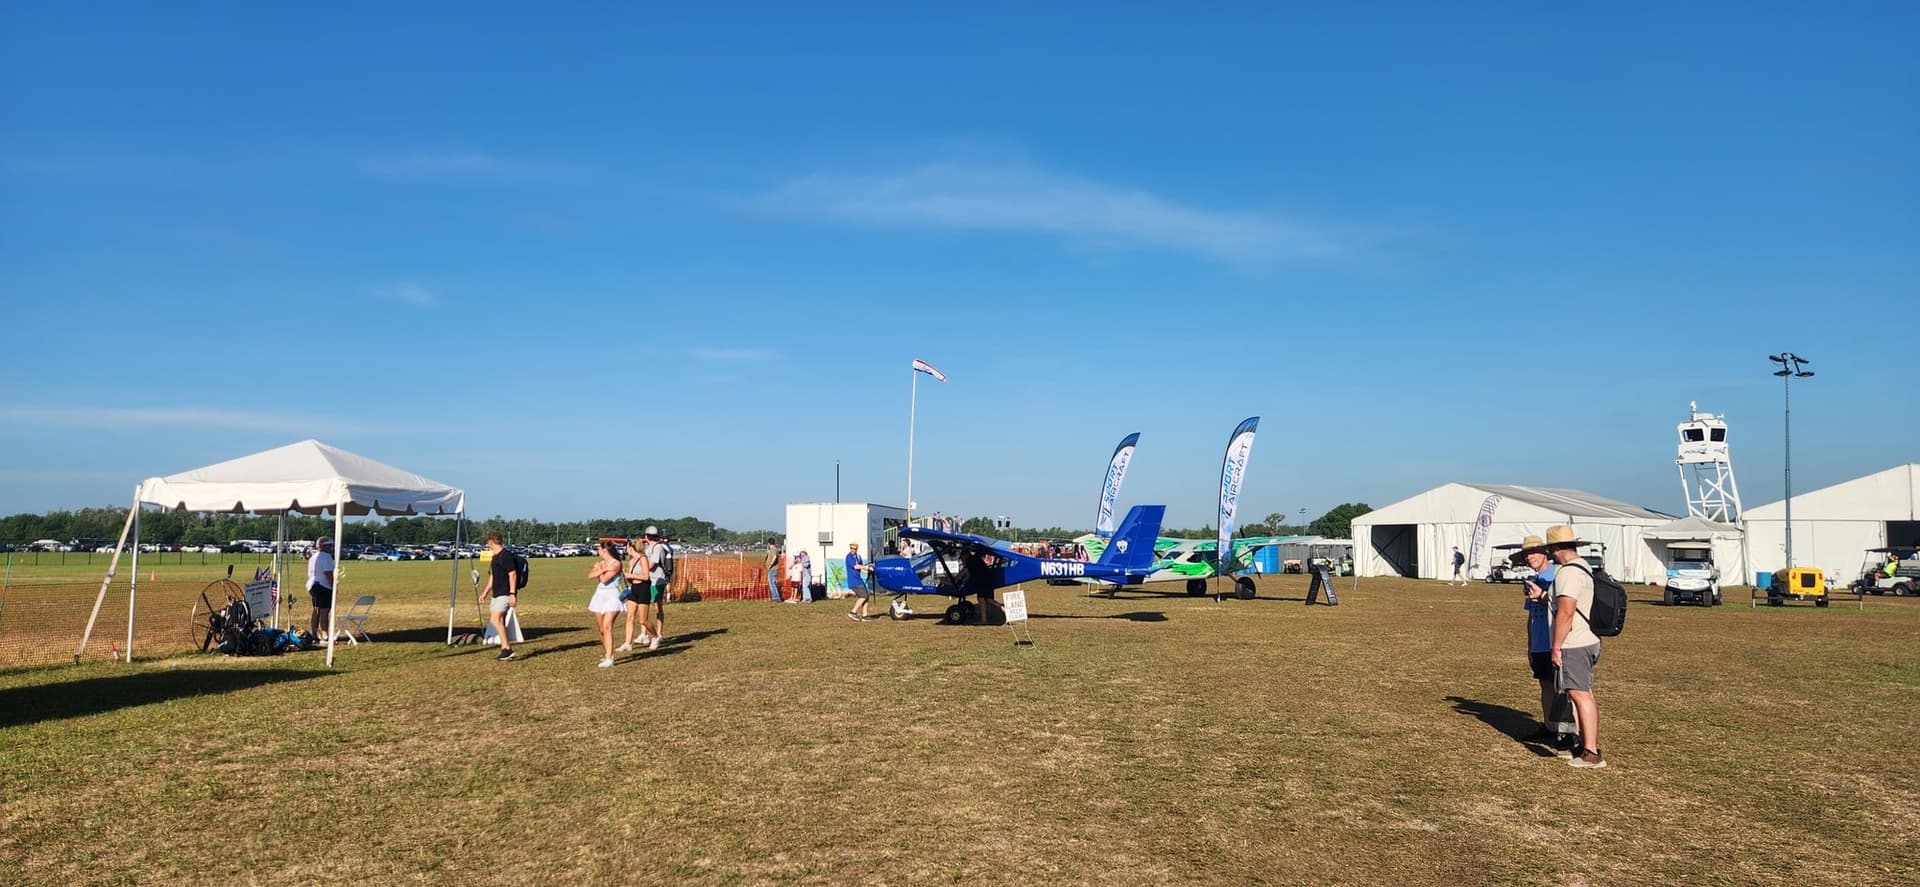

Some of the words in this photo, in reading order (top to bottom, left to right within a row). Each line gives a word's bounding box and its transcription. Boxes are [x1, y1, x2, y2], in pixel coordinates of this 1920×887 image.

[1109, 452, 1129, 507] AIRCRAFT
[1228, 442, 1248, 506] AIRCRAFT
[1041, 561, 1085, 576] N631HB
